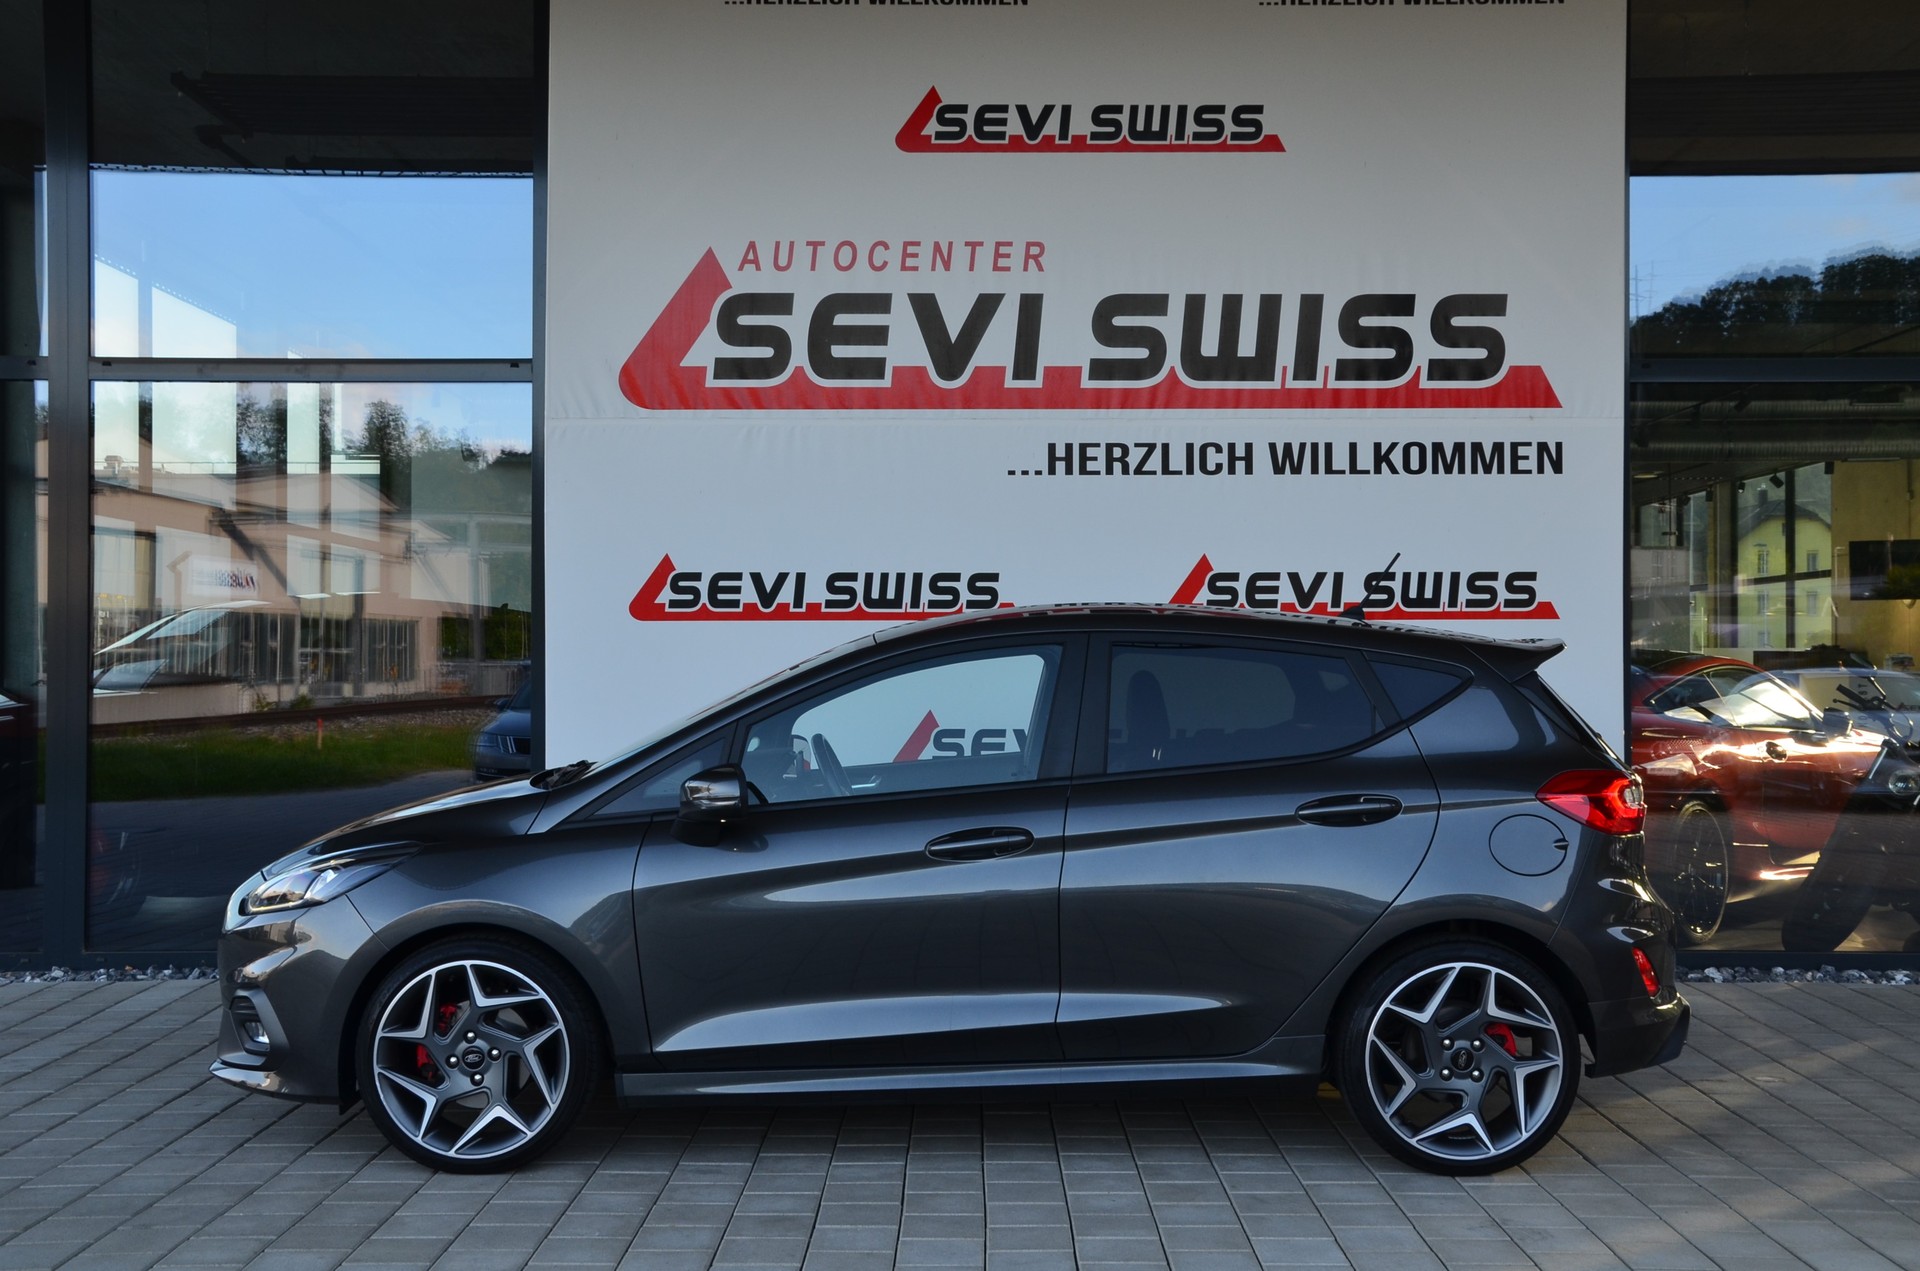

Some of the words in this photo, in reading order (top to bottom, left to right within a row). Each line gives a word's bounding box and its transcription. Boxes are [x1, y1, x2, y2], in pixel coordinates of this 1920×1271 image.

[934, 104, 1072, 142] SEVI
[1089, 104, 1265, 142] SWISS
[737, 240, 1047, 272] AUTOCENTER
[712, 293, 1045, 382] SEVI
[1088, 293, 1509, 382] SWISS
[1007, 442, 1254, 476] ...HERZLICH
[1268, 441, 1564, 475] WILLKOMMEN
[668, 572, 806, 609] SEVI
[824, 572, 1000, 609] SWISS
[1206, 571, 1344, 609] SEVI
[1362, 571, 1538, 608] SWISS
